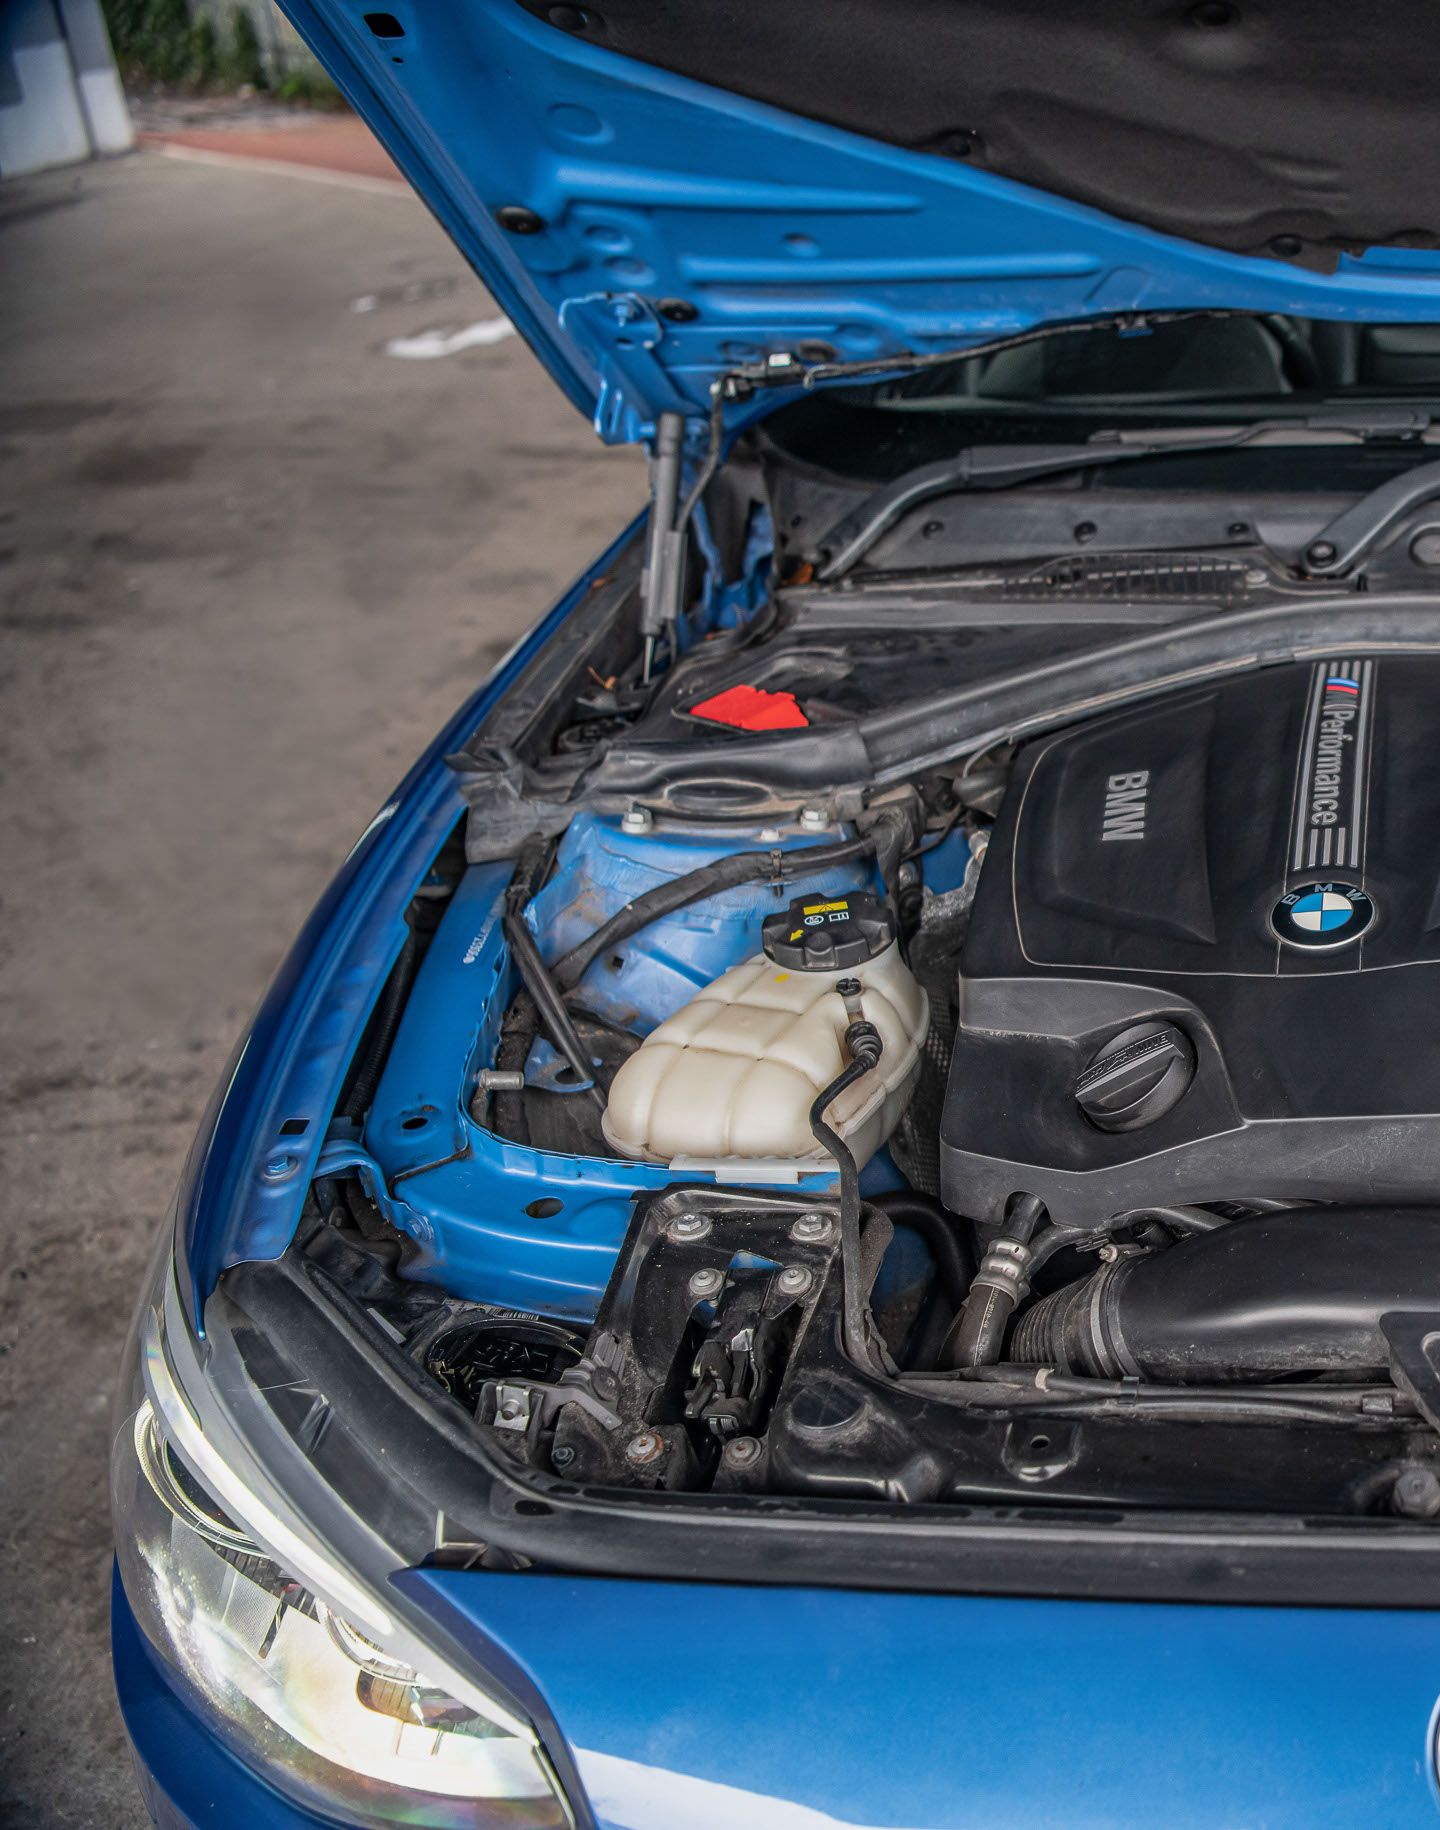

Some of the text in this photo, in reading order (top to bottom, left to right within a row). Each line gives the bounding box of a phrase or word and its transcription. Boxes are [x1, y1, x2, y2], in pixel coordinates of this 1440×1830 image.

[1310, 709, 1355, 825] Performance
[1101, 770, 1149, 841] BMW
[1281, 883, 1366, 906] BMW
